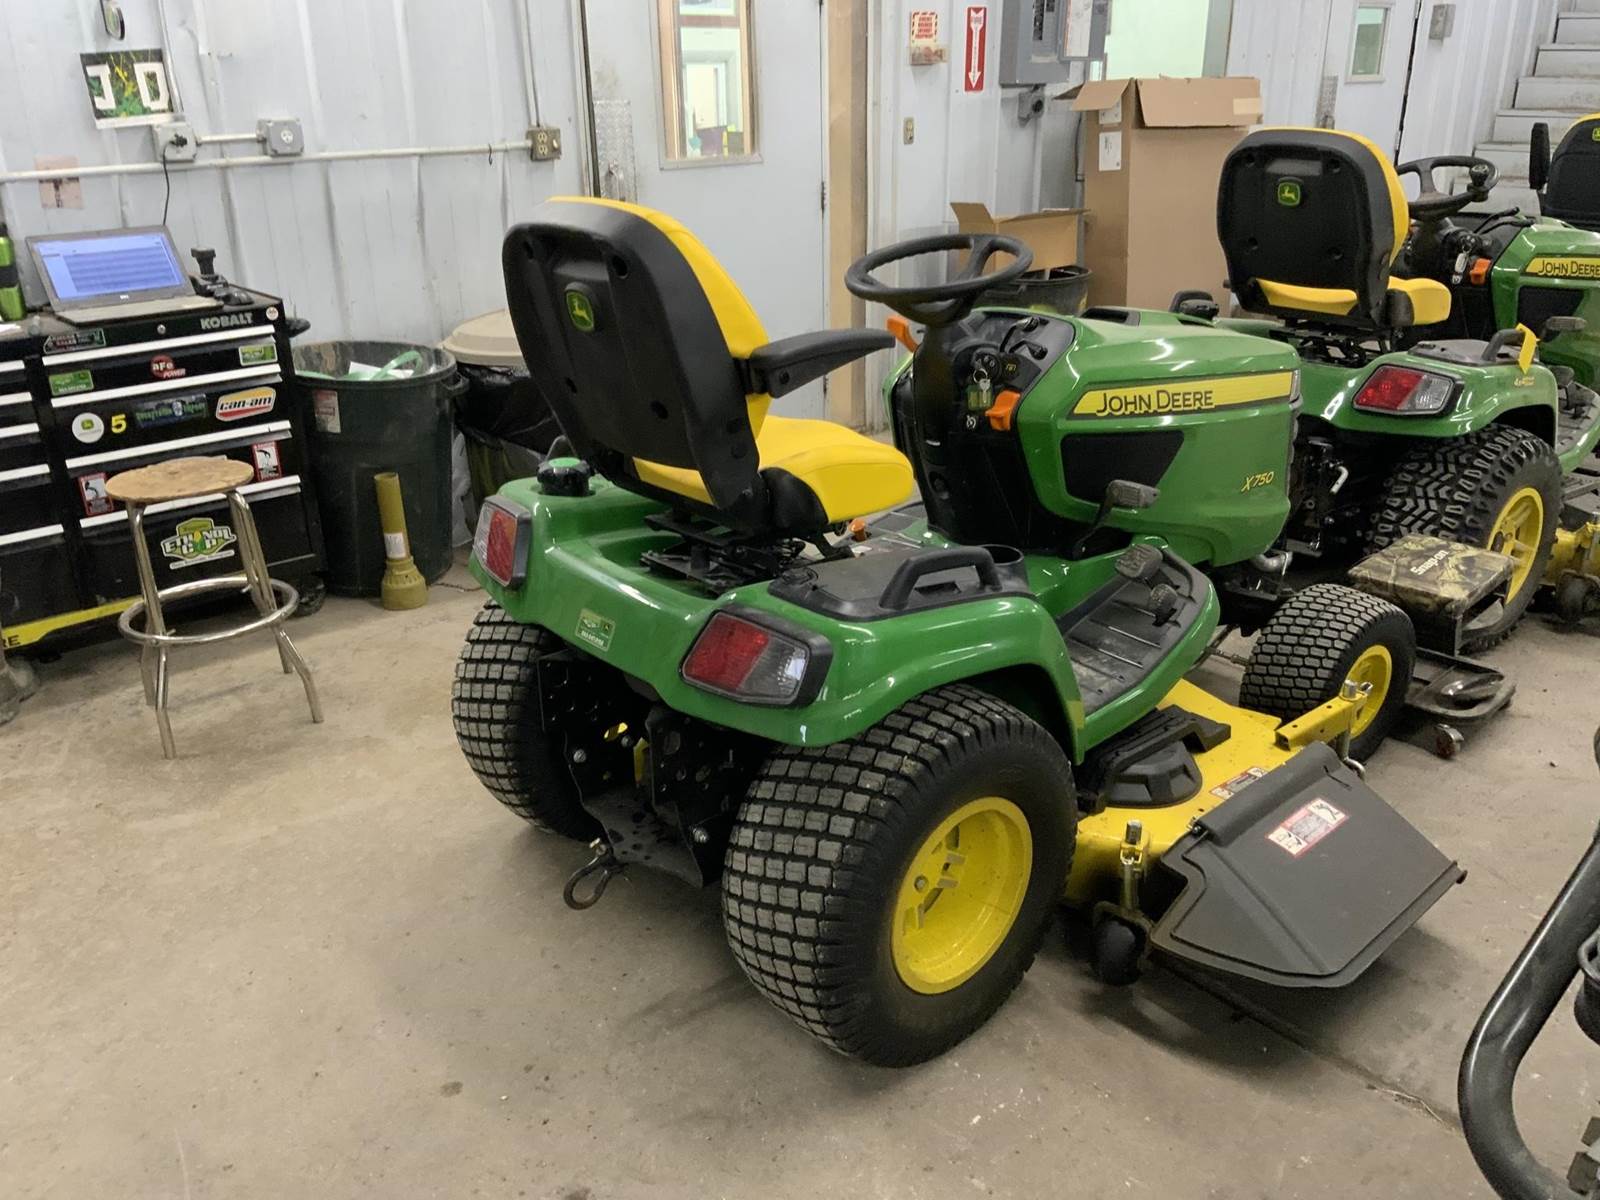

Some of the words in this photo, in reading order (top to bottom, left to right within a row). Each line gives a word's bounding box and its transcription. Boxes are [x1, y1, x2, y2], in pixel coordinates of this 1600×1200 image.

[1538, 260, 1568, 275] JOHN
[1571, 260, 1600, 275] DEERE
[200, 312, 253, 330] KOBALT
[220, 396, 272, 411] can-am
[1096, 393, 1152, 414] JOHN
[1156, 389, 1214, 409] DEERE
[111, 414, 127, 434] 5
[1241, 471, 1275, 492] X750
